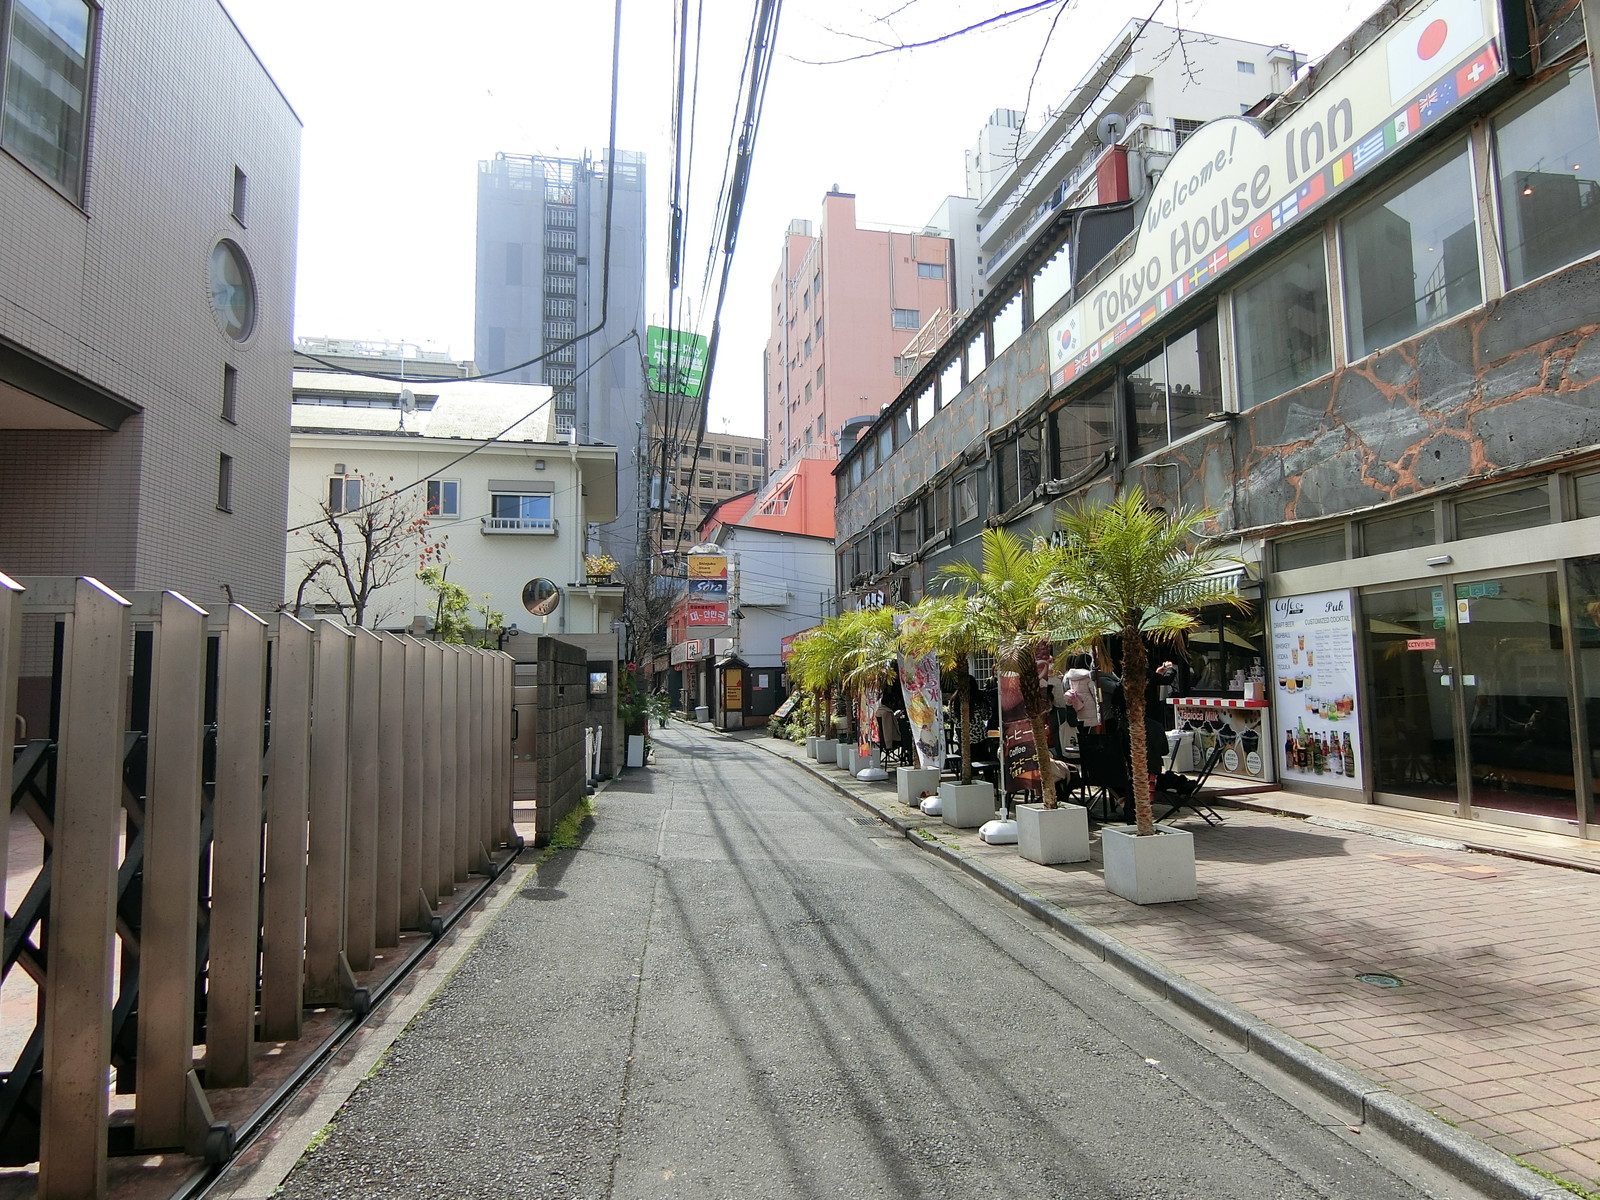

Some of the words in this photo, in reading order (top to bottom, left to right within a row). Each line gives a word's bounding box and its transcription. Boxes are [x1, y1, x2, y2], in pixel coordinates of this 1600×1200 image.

[1148, 126, 1237, 233] Welcome!
[1092, 256, 1161, 332] Tokyo
[1170, 164, 1271, 275] House
[1285, 97, 1353, 184] Inn
[1325, 600, 1345, 613] Pub
[1274, 621, 1285, 629] DRAFT
[1285, 620, 1295, 628] BEER
[1305, 617, 1330, 626] CUSTOMIZED
[1330, 615, 1351, 624] COCKTAIL
[1181, 709, 1204, 720] Tapioca
[1205, 712, 1219, 721] Milk
[1009, 745, 1026, 758] Coffee
